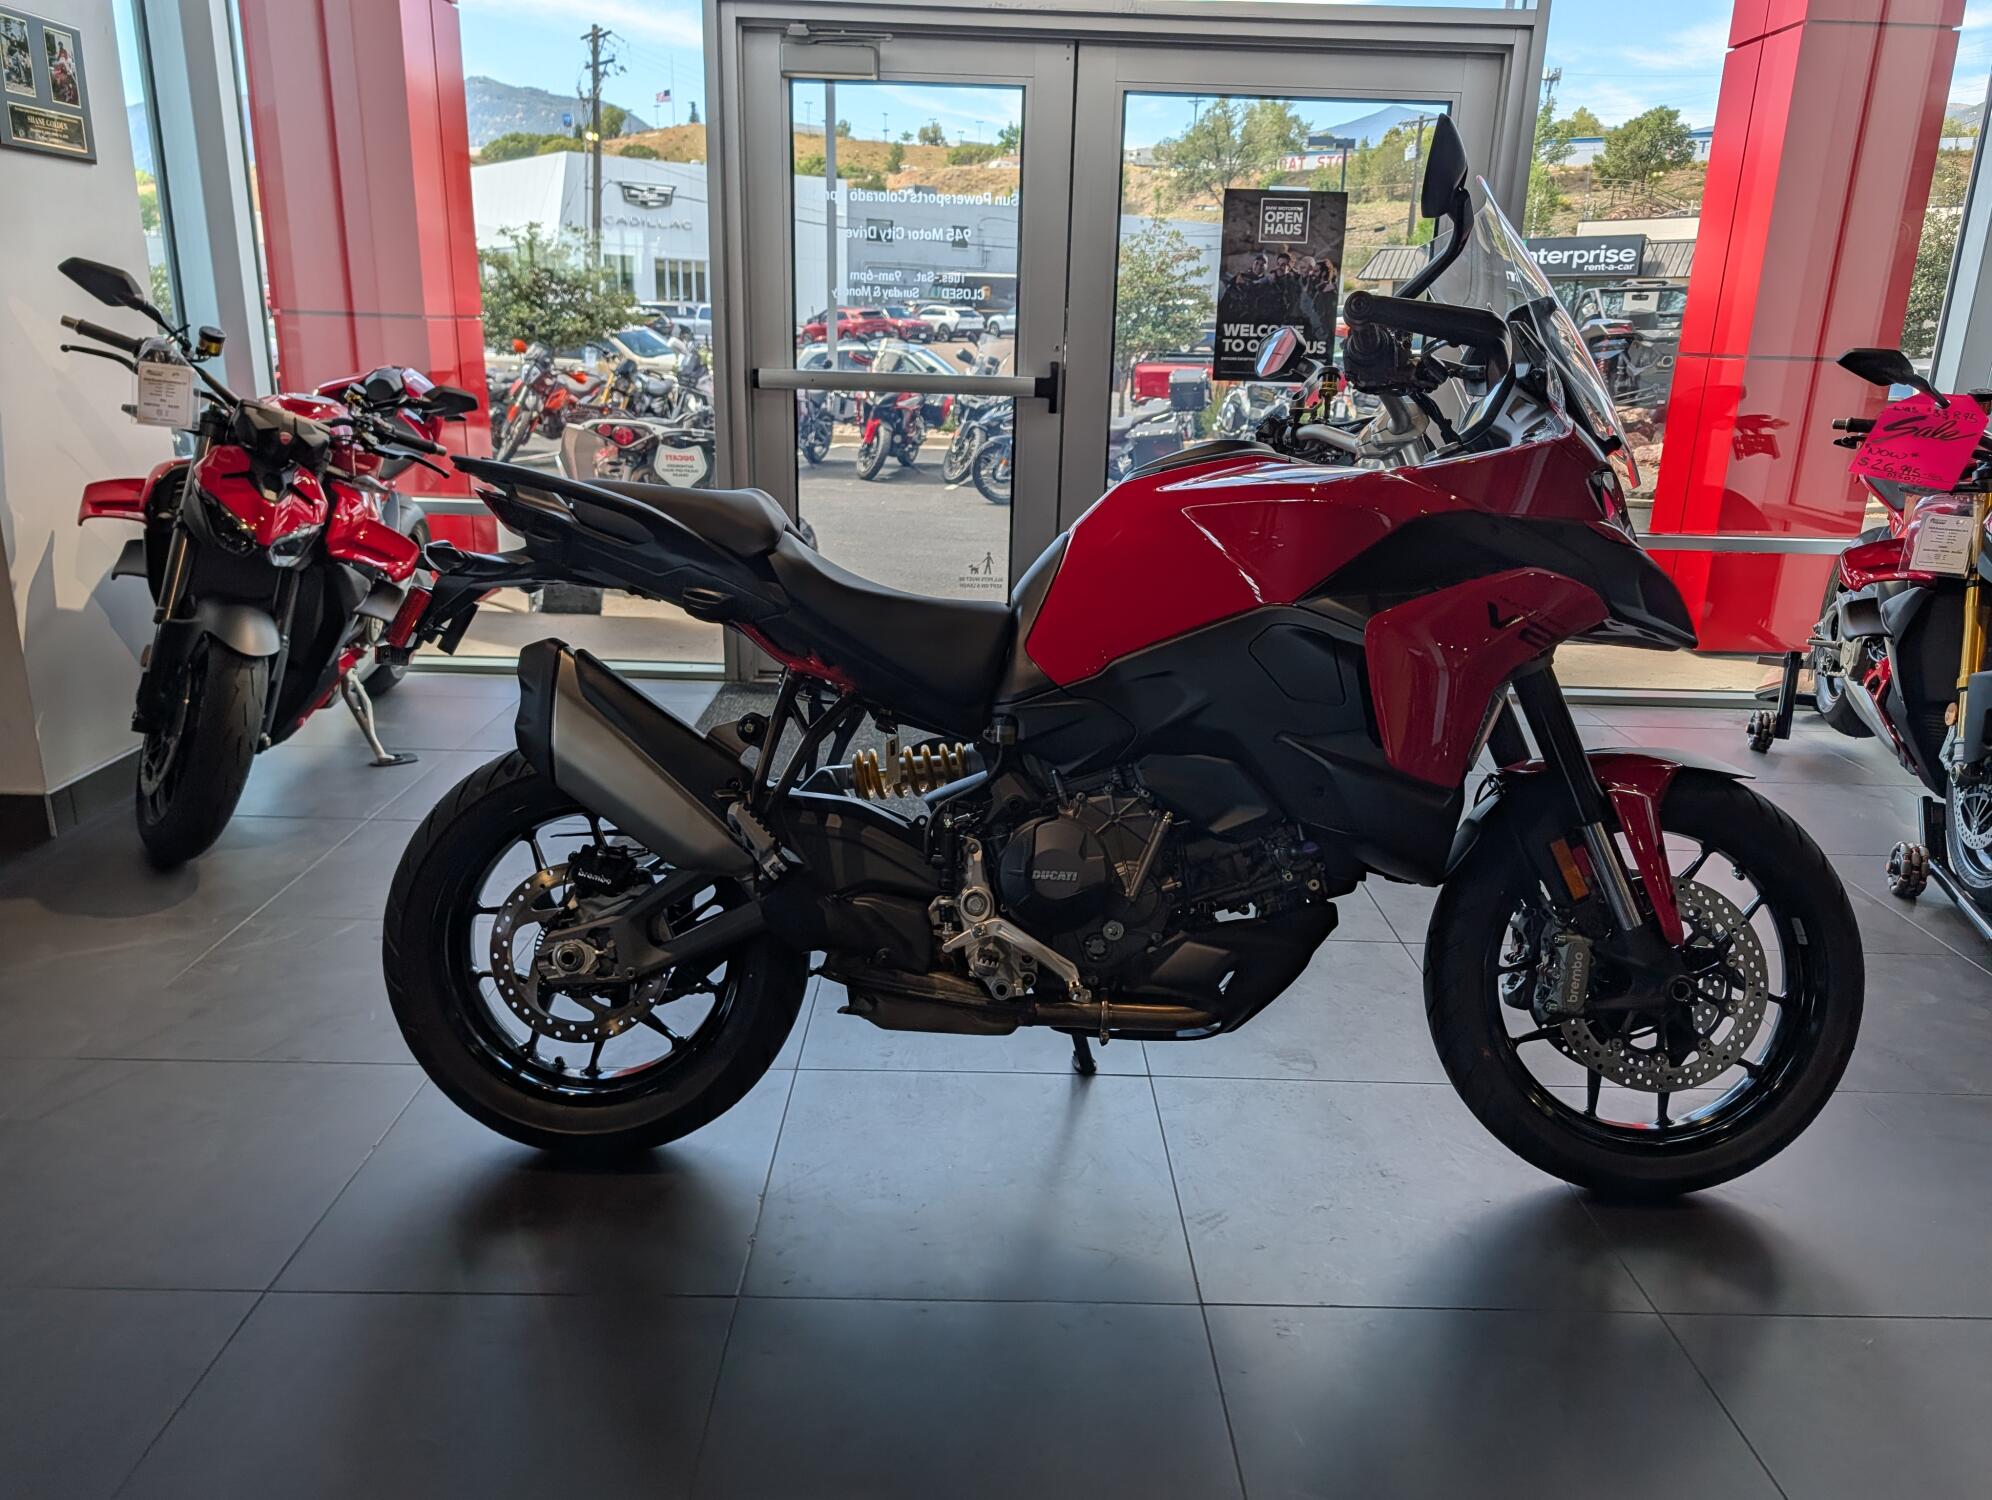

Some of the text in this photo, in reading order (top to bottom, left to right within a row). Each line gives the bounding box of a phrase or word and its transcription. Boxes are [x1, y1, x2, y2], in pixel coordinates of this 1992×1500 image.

[603, 215, 693, 231] CADILLAC
[1264, 211, 1304, 224] OPEN
[1264, 223, 1302, 236] HAUS
[1528, 244, 1637, 269] nterprise
[1583, 263, 1635, 271] rent-a-car
[1223, 323, 1305, 338] WELCOE
[1222, 338, 1245, 353] TO
[1871, 415, 1978, 443] Sale
[578, 867, 612, 886] brembo
[1032, 869, 1078, 881] DUCATI
[1567, 951, 1584, 1003] brembo
